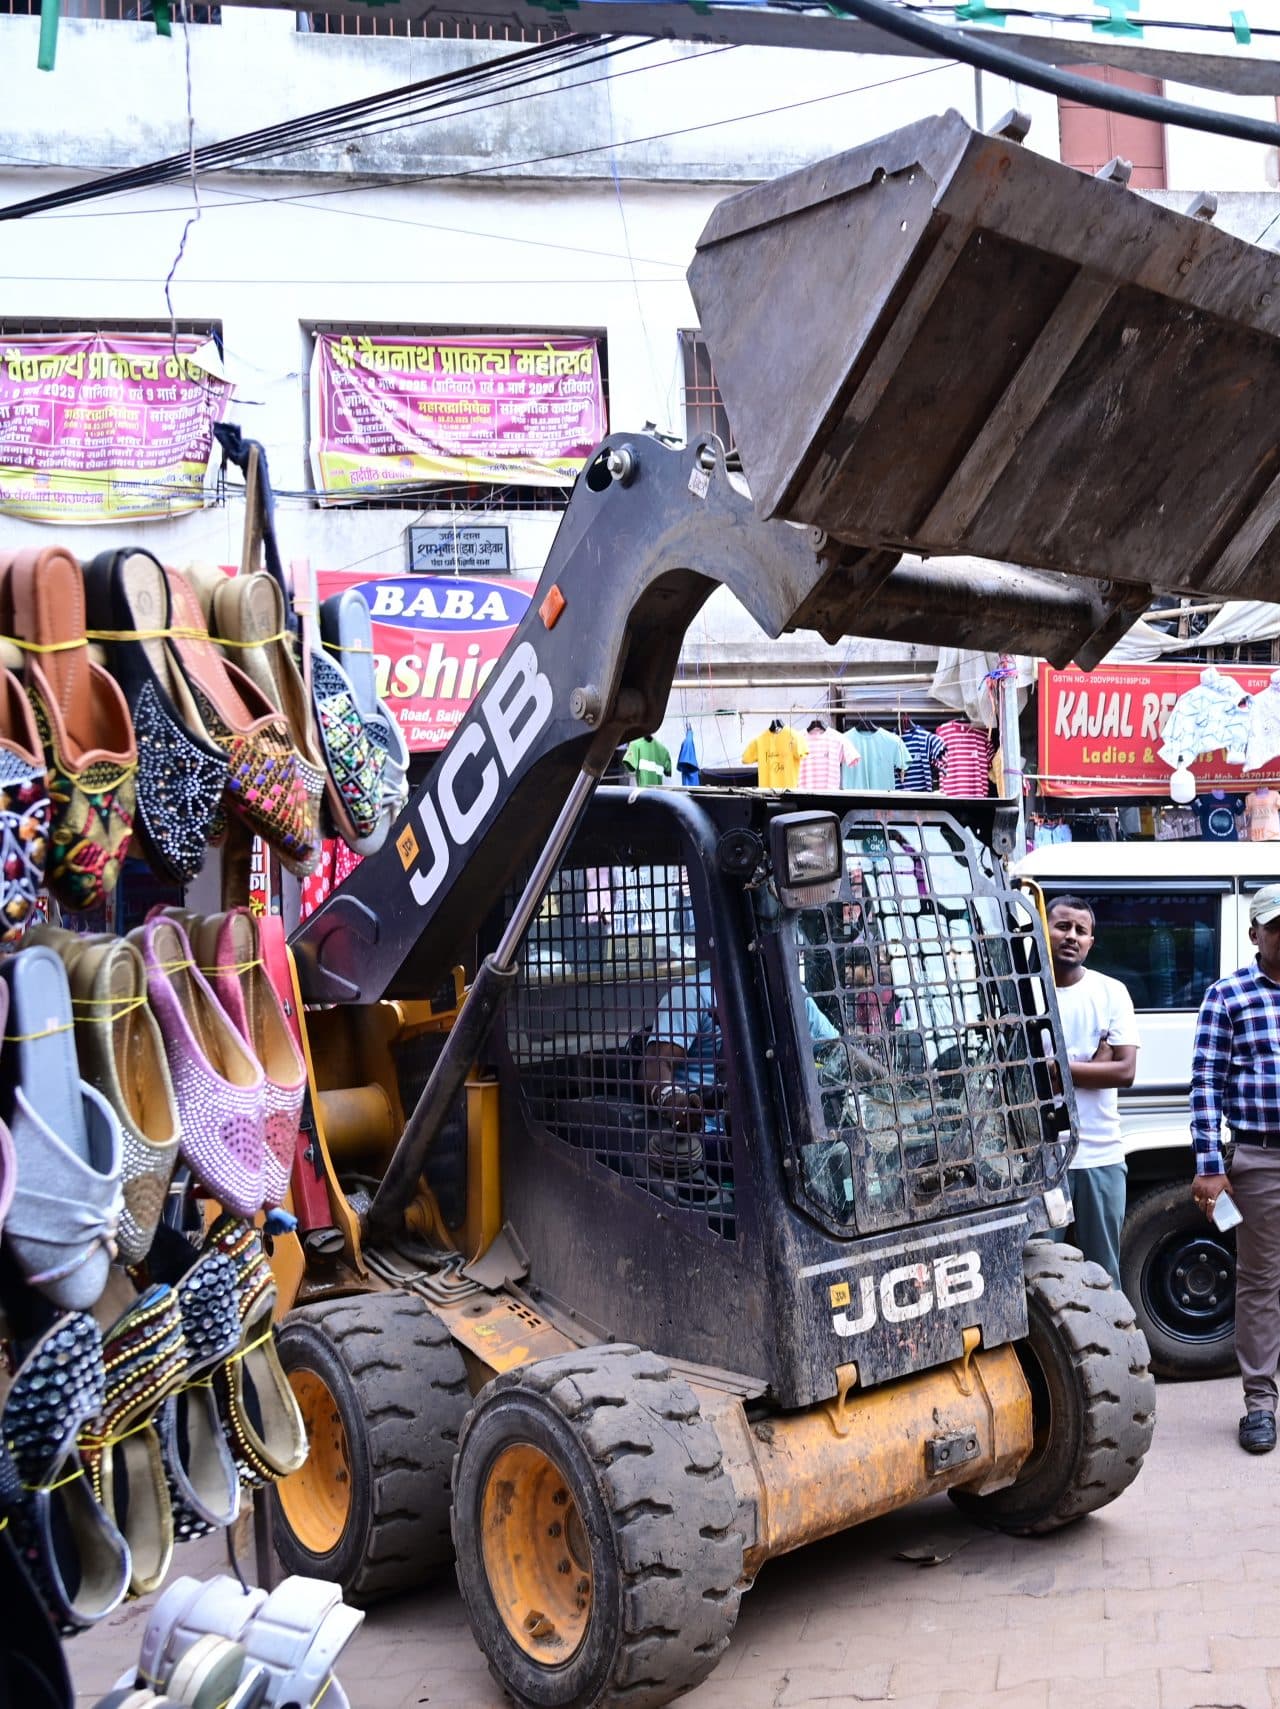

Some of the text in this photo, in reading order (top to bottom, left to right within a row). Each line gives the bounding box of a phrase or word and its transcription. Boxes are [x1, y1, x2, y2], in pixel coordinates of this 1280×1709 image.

[6, 349, 160, 383] वैद्यनाथ प्राकट्य
[331, 337, 593, 376] श्री वैद्यनाथ प्राकट्य महोत्सव
[370, 585, 510, 621] BABA
[1247, 680, 1268, 688] STATE
[400, 709, 432, 722] Road,
[1054, 689, 1135, 740] KAJAL
[1082, 746, 1156, 764] Ladies &
[409, 641, 553, 906] JCB
[832, 1250, 985, 1337] JCB
